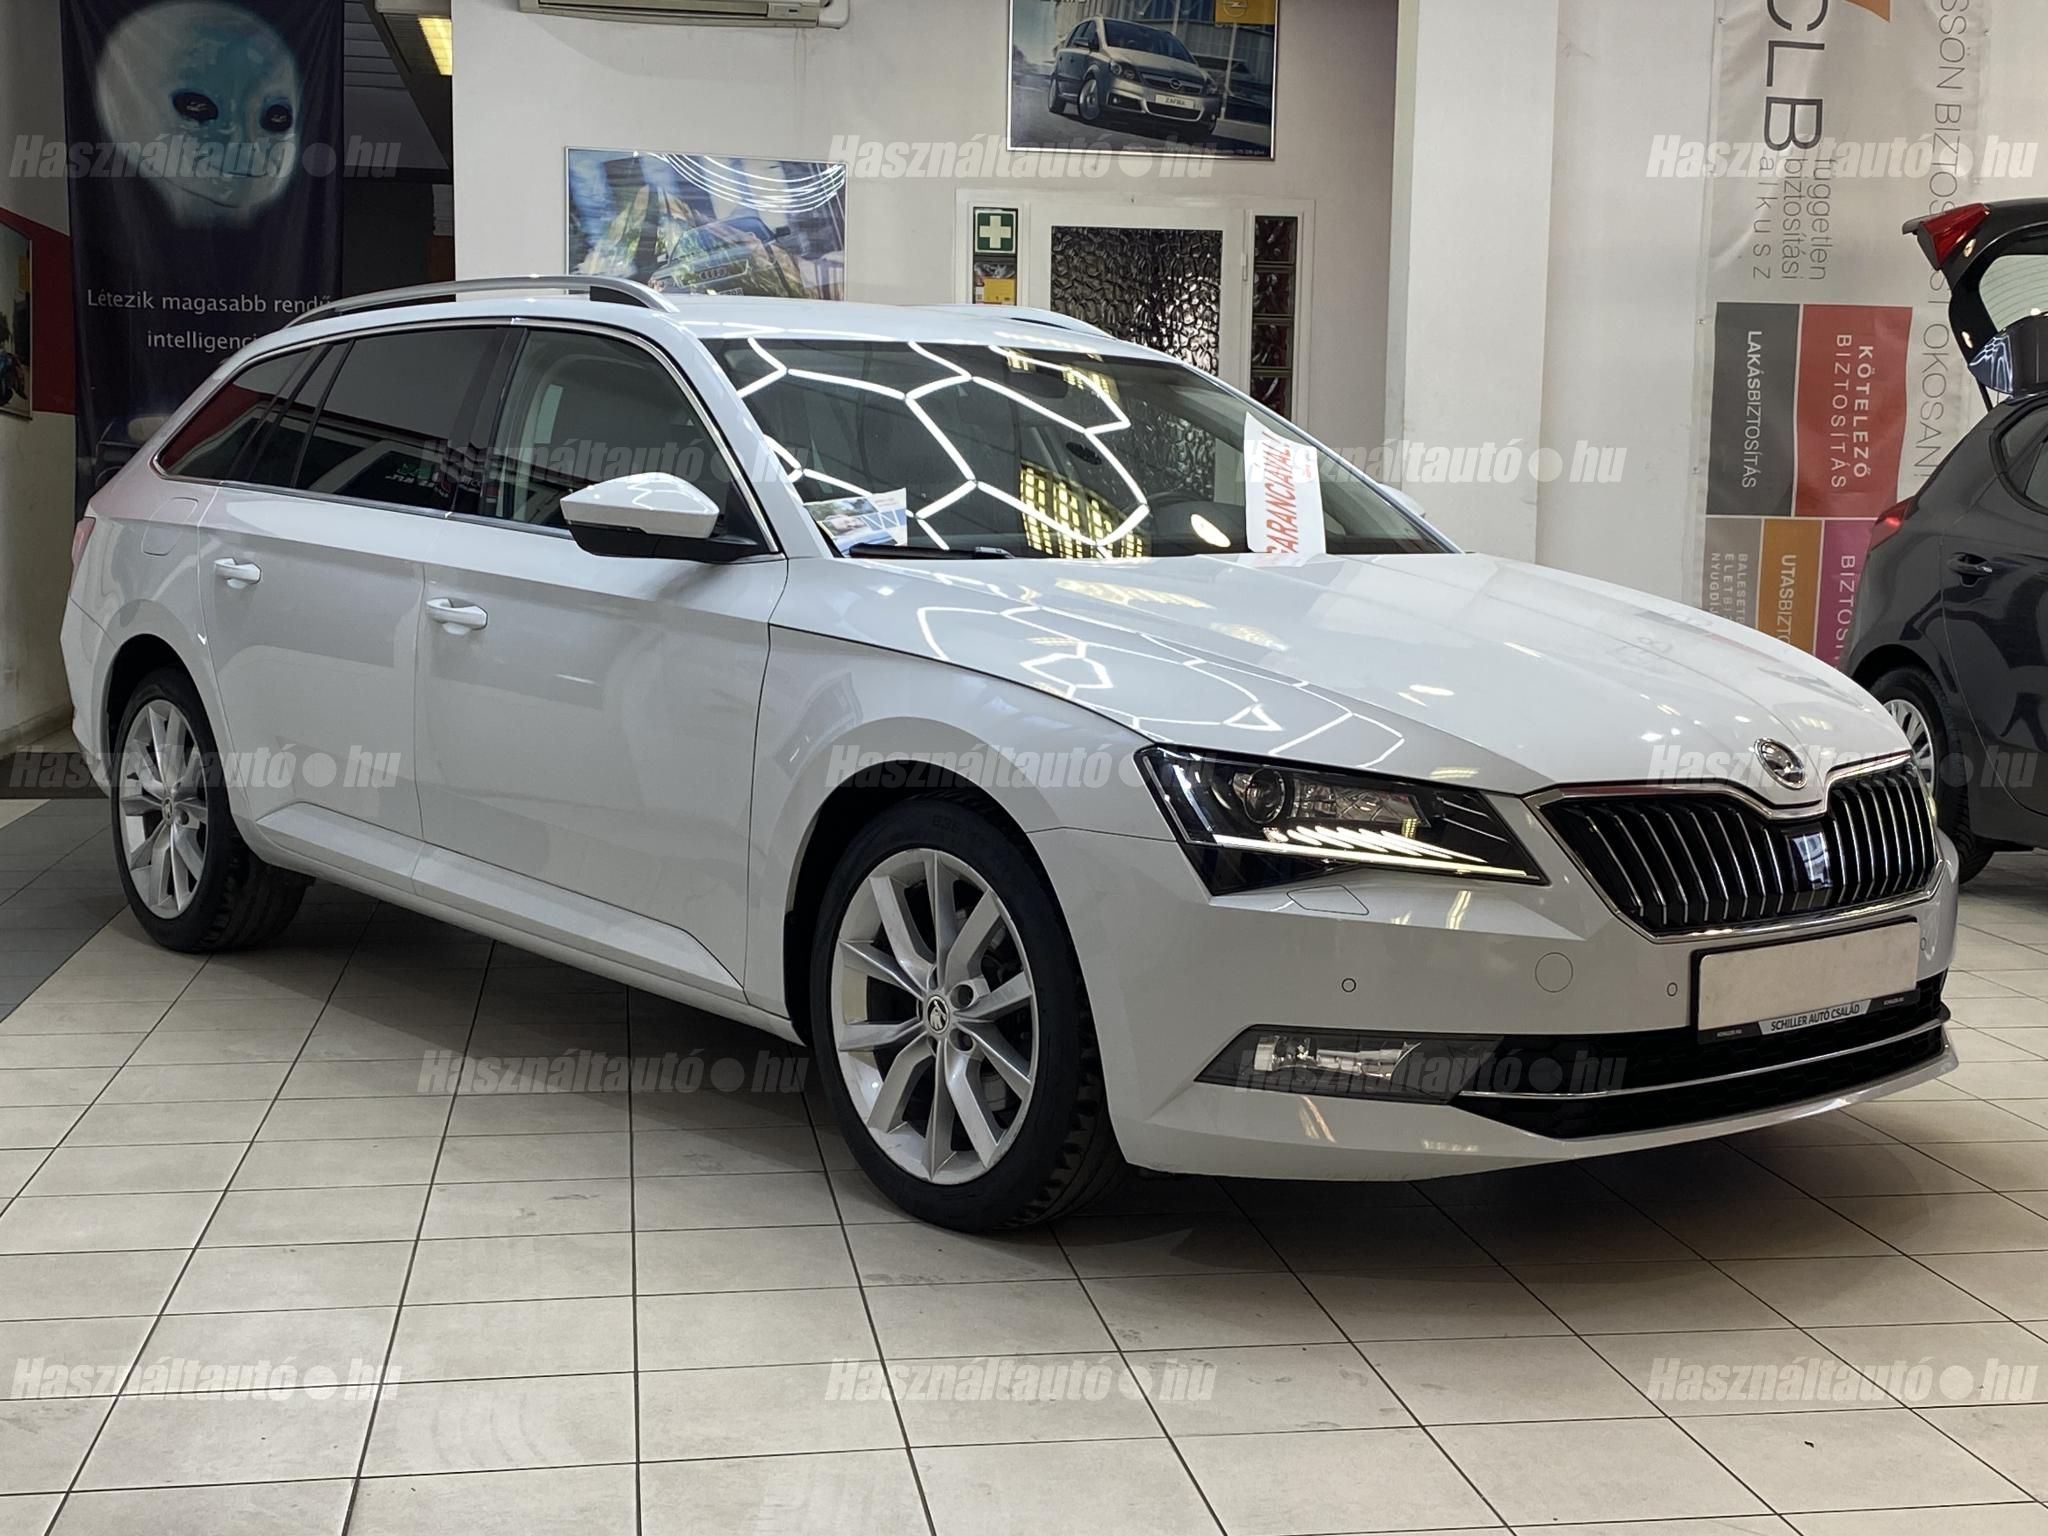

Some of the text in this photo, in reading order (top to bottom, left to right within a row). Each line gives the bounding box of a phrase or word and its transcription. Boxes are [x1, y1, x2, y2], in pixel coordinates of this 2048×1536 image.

[1752, 156, 1779, 280] alkusz
[1782, 158, 1809, 280] biztosítási
[87, 289, 154, 311] Létezik
[162, 294, 266, 315] magasabb
[1741, 331, 1764, 488] LAKÁSBIZTOSÍTÁS
[1829, 334, 1852, 488] BIZTOSÍTÁS
[1853, 345, 1875, 478] KÖTELEZŐ
[1770, 1015, 1807, 1031] SCHILLER
